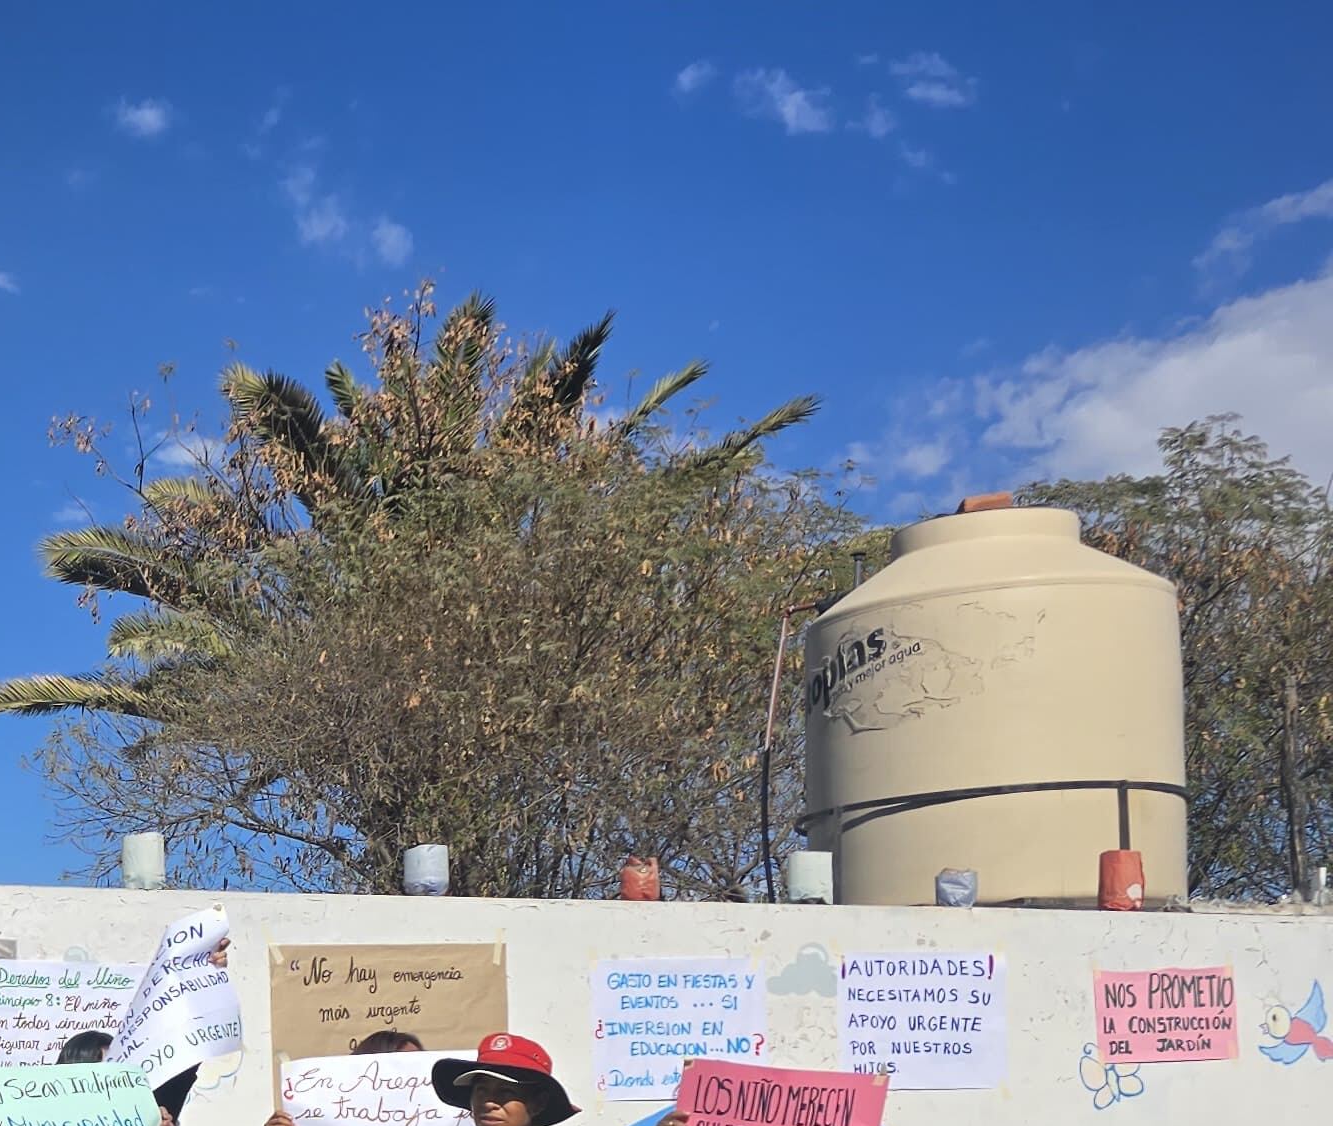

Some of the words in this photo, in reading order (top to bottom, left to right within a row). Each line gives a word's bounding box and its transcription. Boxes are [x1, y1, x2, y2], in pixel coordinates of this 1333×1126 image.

[889, 642, 921, 664] agua
[345, 956, 377, 993] hay
[393, 967, 463, 989] emergencia
[607, 972, 651, 990] GASTO
[658, 974, 677, 987] EN
[683, 974, 738, 989] FIESTAS
[745, 975, 756, 989] Y
[847, 987, 958, 1003] NECESITAMOS
[968, 990, 991, 1006] SU
[1105, 983, 1137, 1008] NOS
[1148, 973, 1234, 1009] PROMETIO
[82, 998, 121, 1012] niño
[319, 1004, 350, 1023] más
[366, 996, 421, 1024] urgente
[621, 996, 679, 1010] EVENTOS
[721, 995, 738, 1010] SI
[702, 1021, 723, 1036] EN
[848, 1013, 897, 1030] APOYO
[908, 1015, 982, 1032] URGENTE
[1103, 1017, 1116, 1034] LA
[1128, 1010, 1232, 1034] CONSTRUCCIÓN
[850, 1041, 877, 1055] POR
[891, 1041, 972, 1054] NUESTROS
[1109, 1041, 1132, 1055] DEL
[1156, 1034, 1211, 1052] JARDÍN
[693, 1075, 733, 1116] LOS
[733, 1079, 782, 1123] NIÑO
[295, 1108, 325, 1119] se
